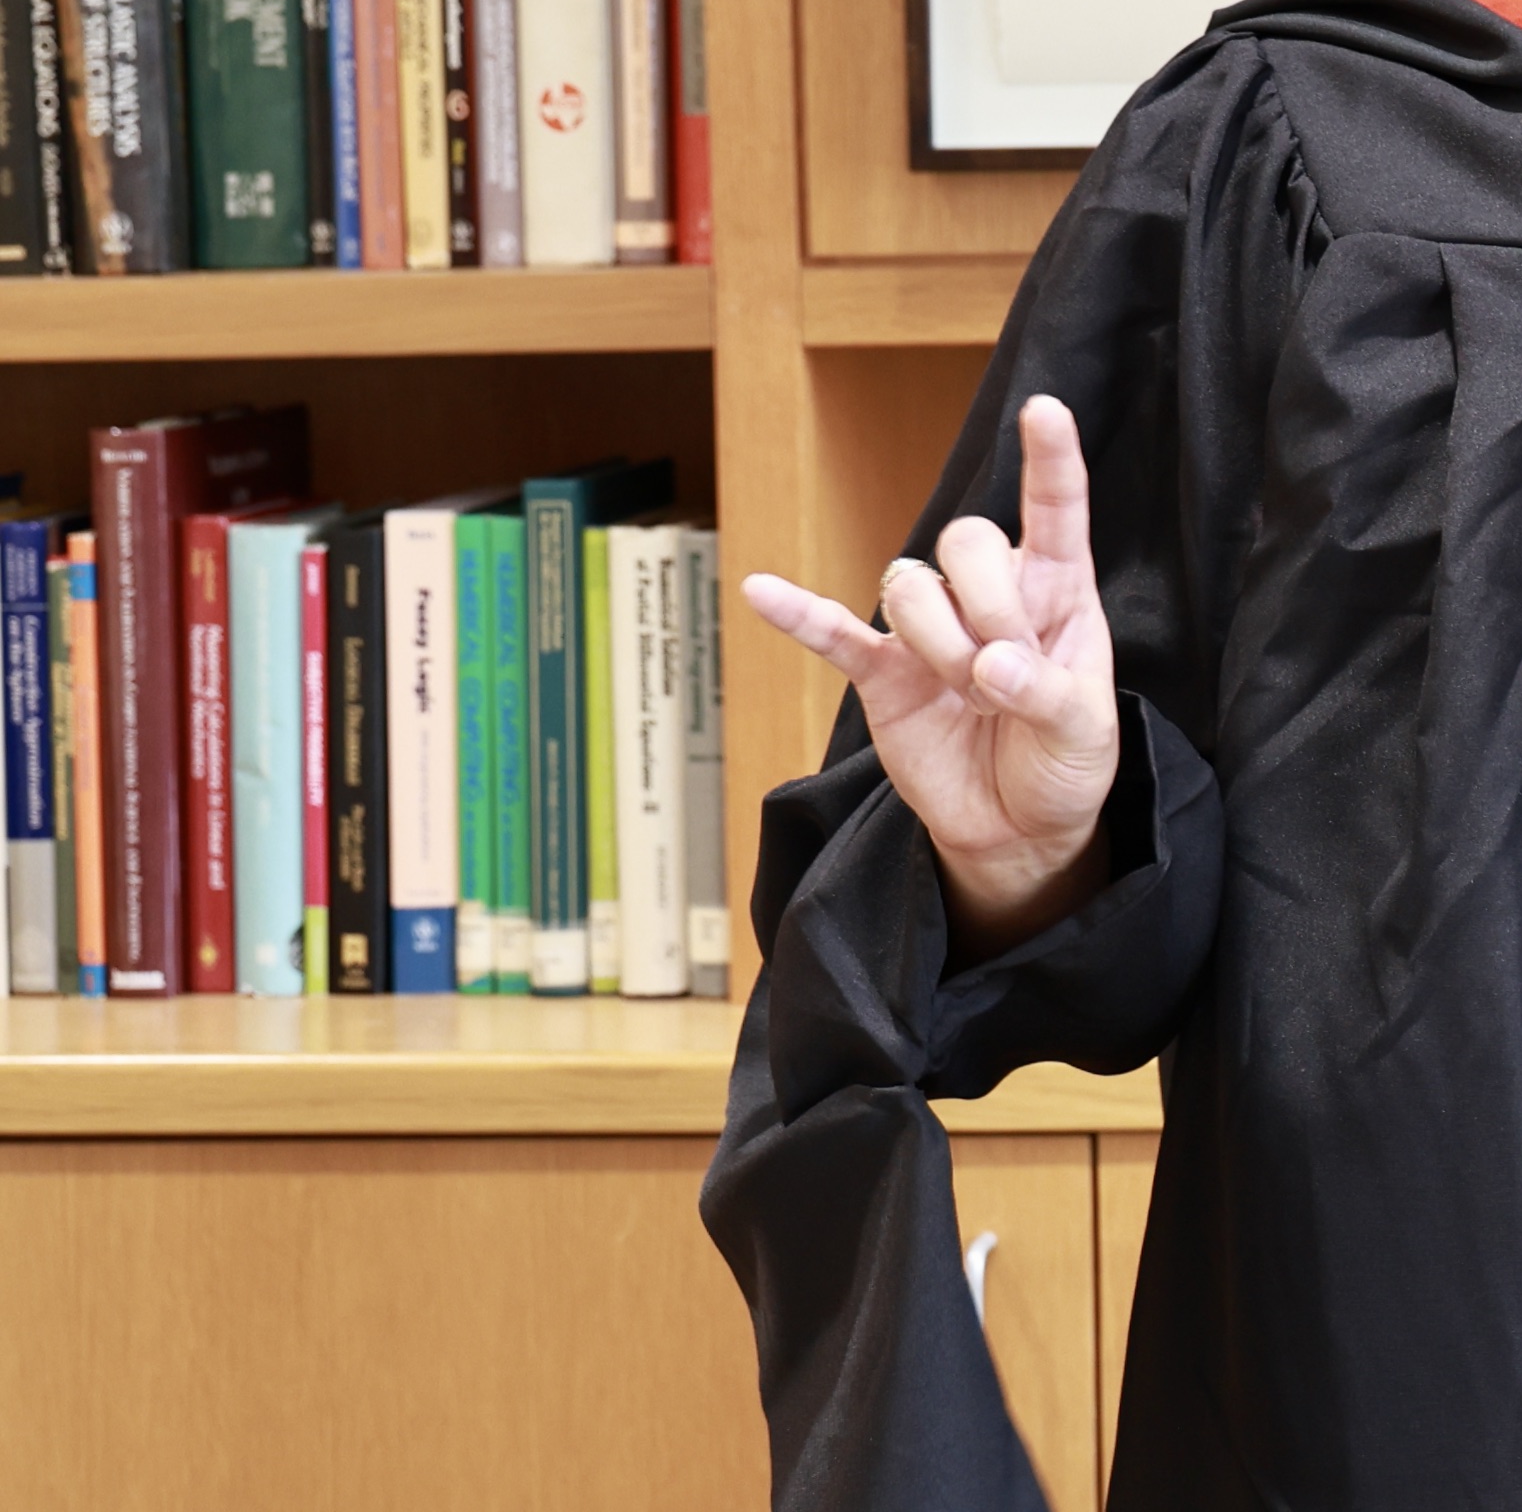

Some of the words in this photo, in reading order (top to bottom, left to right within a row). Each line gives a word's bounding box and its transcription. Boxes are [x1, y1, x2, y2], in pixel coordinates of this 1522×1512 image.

[32, 26, 61, 138] EQUATIONS
[80, 12, 112, 138] STRUCTURES
[113, 60, 142, 159] ANALYSIS
[636, 558, 653, 571] of
[637, 578, 656, 626] Partial
[659, 557, 678, 633] Numerical
[8, 615, 21, 632] on
[414, 588, 432, 650] Fuzzy
[457, 548, 482, 666] NUMERICAL
[495, 551, 519, 666] NUMERICAL
[9, 635, 25, 662] the
[18, 615, 42, 710] Constructive
[188, 624, 206, 695] Nonlinear
[202, 624, 225, 699] Mastering
[414, 657, 433, 714] Logic
[638, 631, 659, 715] Differential
[661, 637, 679, 697] Solution
[5, 666, 26, 725] Sphere
[21, 715, 45, 829] Approximation
[190, 698, 209, 780] Mechanics
[205, 702, 226, 789] Calculations
[461, 677, 485, 804] COMPUTING
[499, 680, 522, 806] COMPUTING
[638, 719, 661, 788] Equations
[207, 811, 227, 856] Linear
[209, 792, 226, 807] in
[209, 859, 228, 889] and
